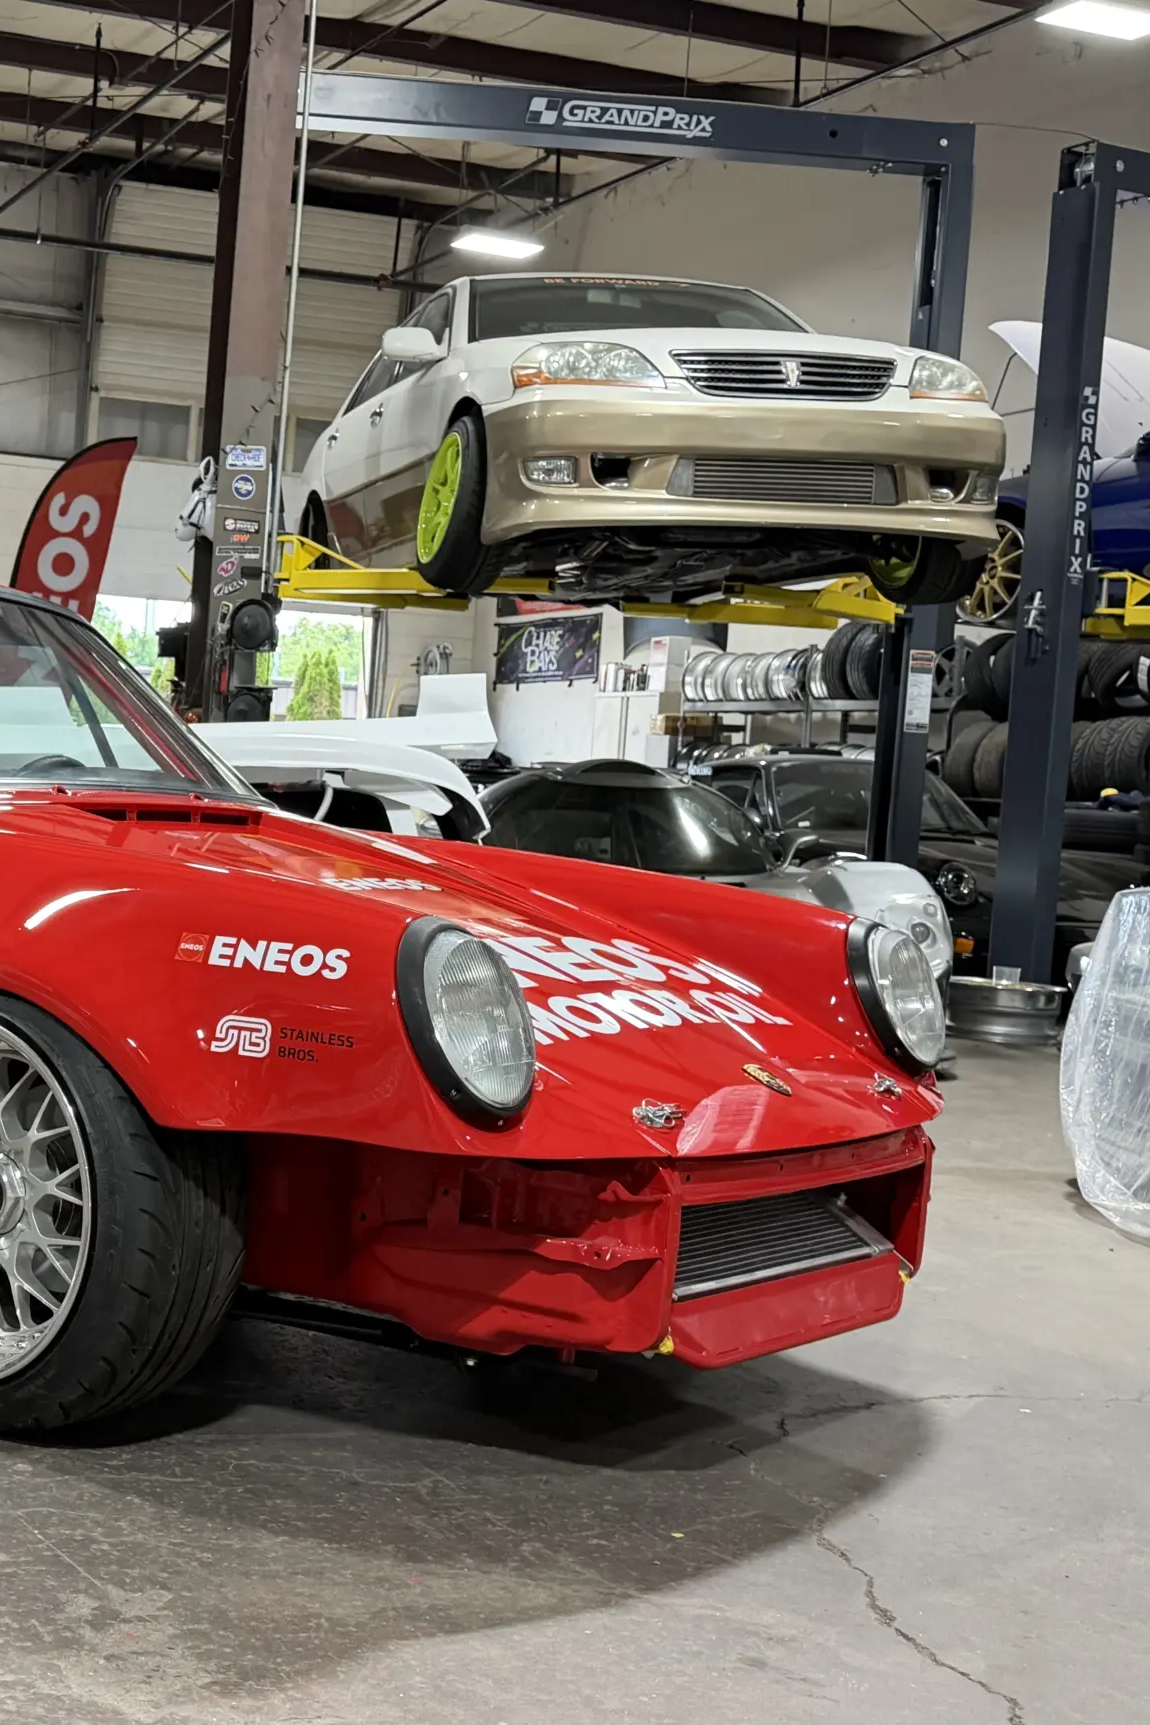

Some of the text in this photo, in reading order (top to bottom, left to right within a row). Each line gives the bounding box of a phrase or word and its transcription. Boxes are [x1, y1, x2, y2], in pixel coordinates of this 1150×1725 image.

[562, 100, 716, 138] GRANDPRIX
[570, 278, 661, 287] FORWARD
[1069, 408, 1096, 573] GRANDPRIX
[33, 491, 101, 613] OS
[180, 941, 204, 951] ENEOS
[208, 935, 351, 980] ENEOS
[484, 936, 711, 988] NEOS
[279, 1026, 355, 1049] STAINLESS
[527, 989, 794, 1046] MOTOR OIL
[277, 1045, 319, 1063] BROS.
